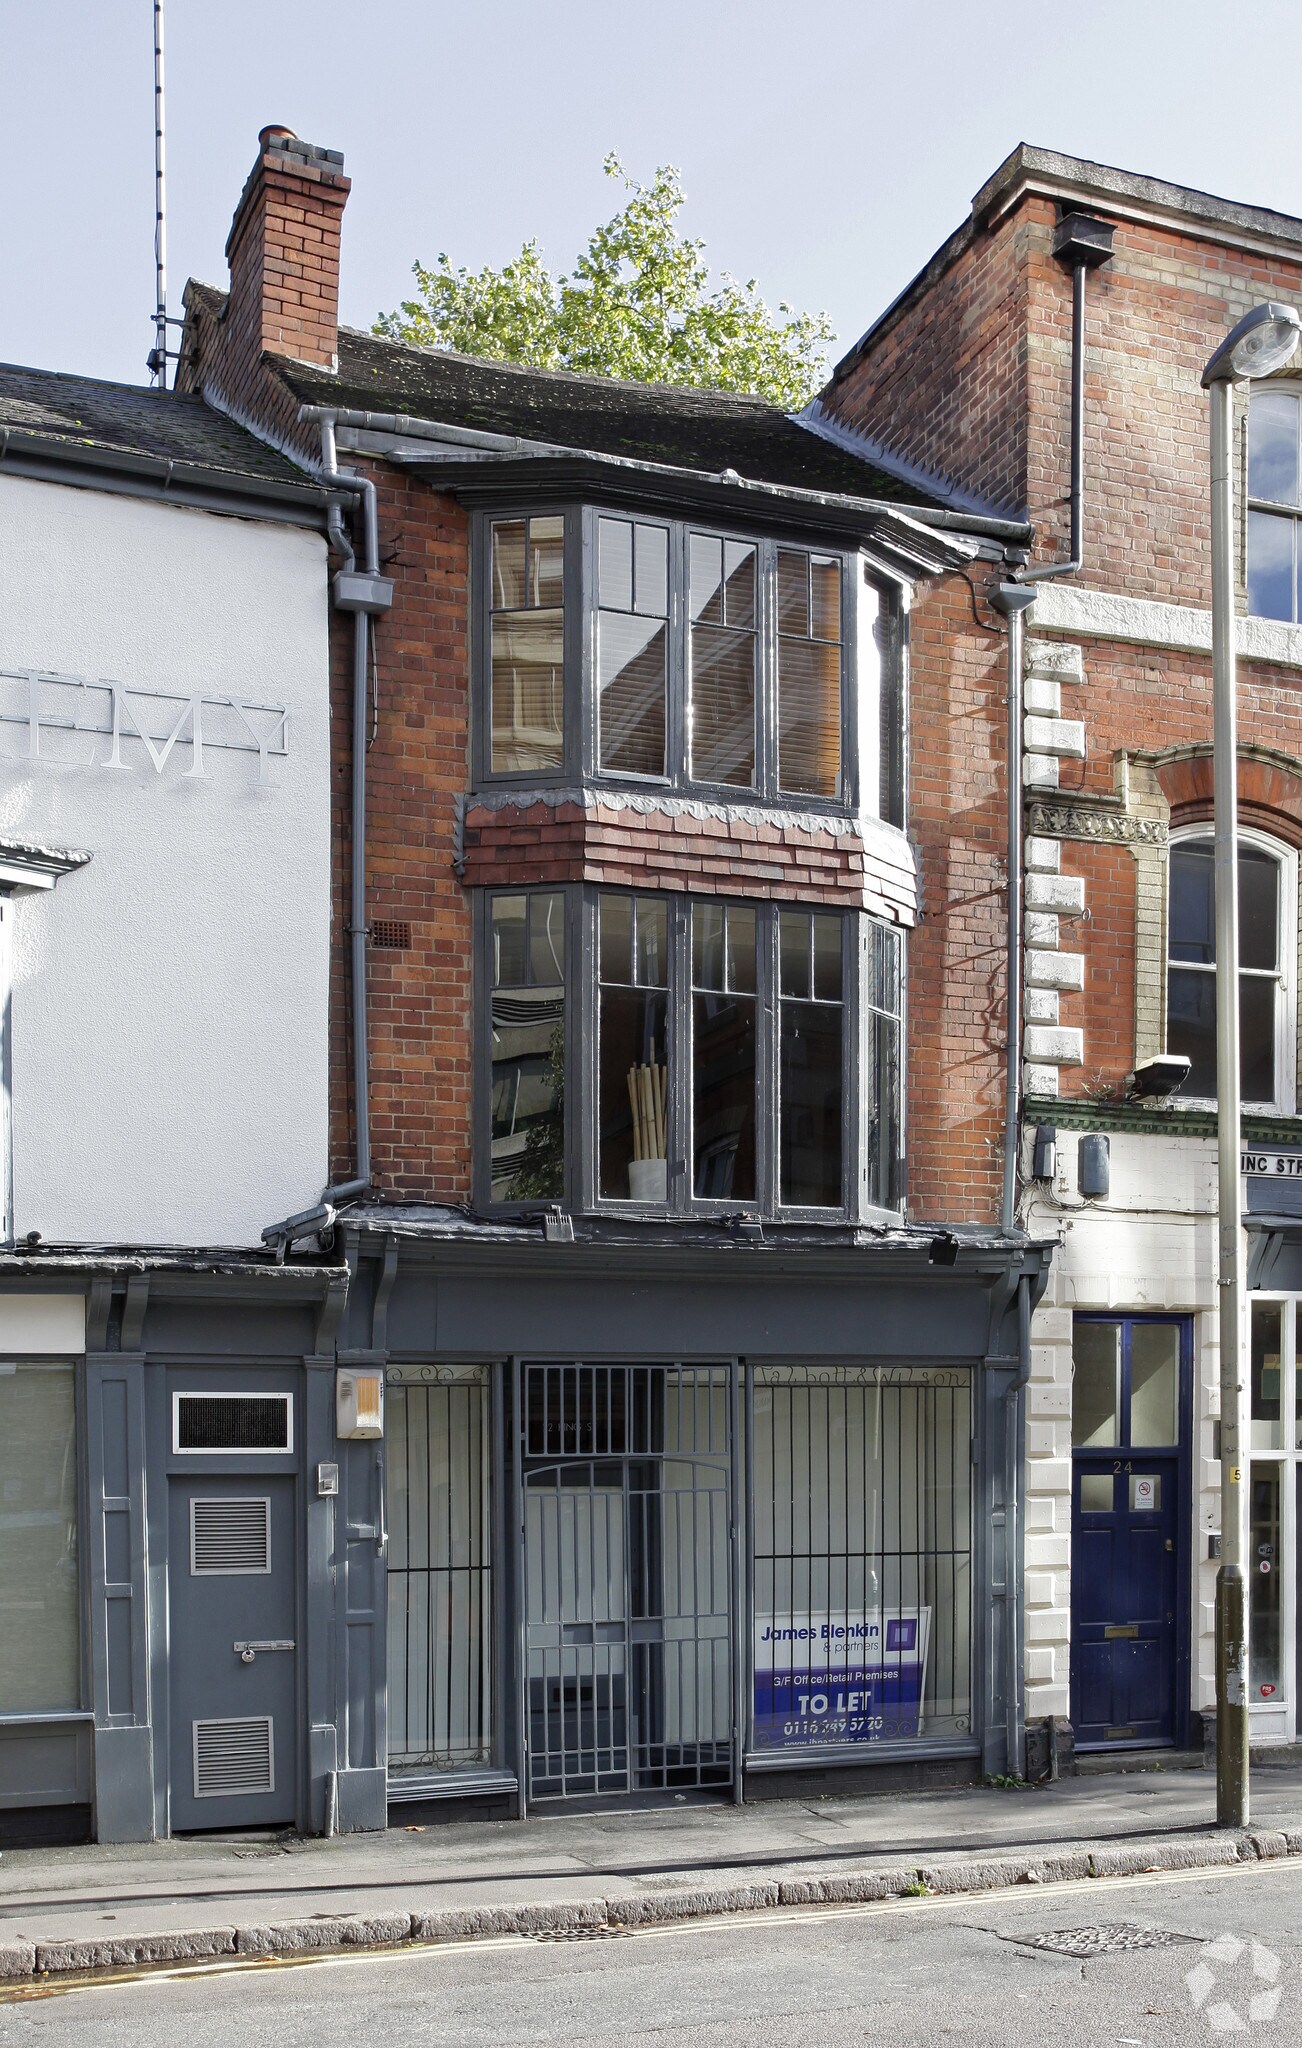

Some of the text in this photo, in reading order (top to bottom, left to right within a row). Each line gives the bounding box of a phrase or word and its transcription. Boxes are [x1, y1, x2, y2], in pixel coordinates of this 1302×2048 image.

[0, 667, 302, 788] EMY
[1113, 1460, 1133, 1474] 24
[761, 1623, 879, 1642] James Blenkin
[823, 1641, 879, 1654] & partners
[774, 1676, 791, 1687] G/F
[794, 1672, 853, 1685] Offce/Retail
[798, 1691, 871, 1715] TO LET
[783, 1720, 818, 1736] 0116
[849, 1716, 883, 1732] 5720
